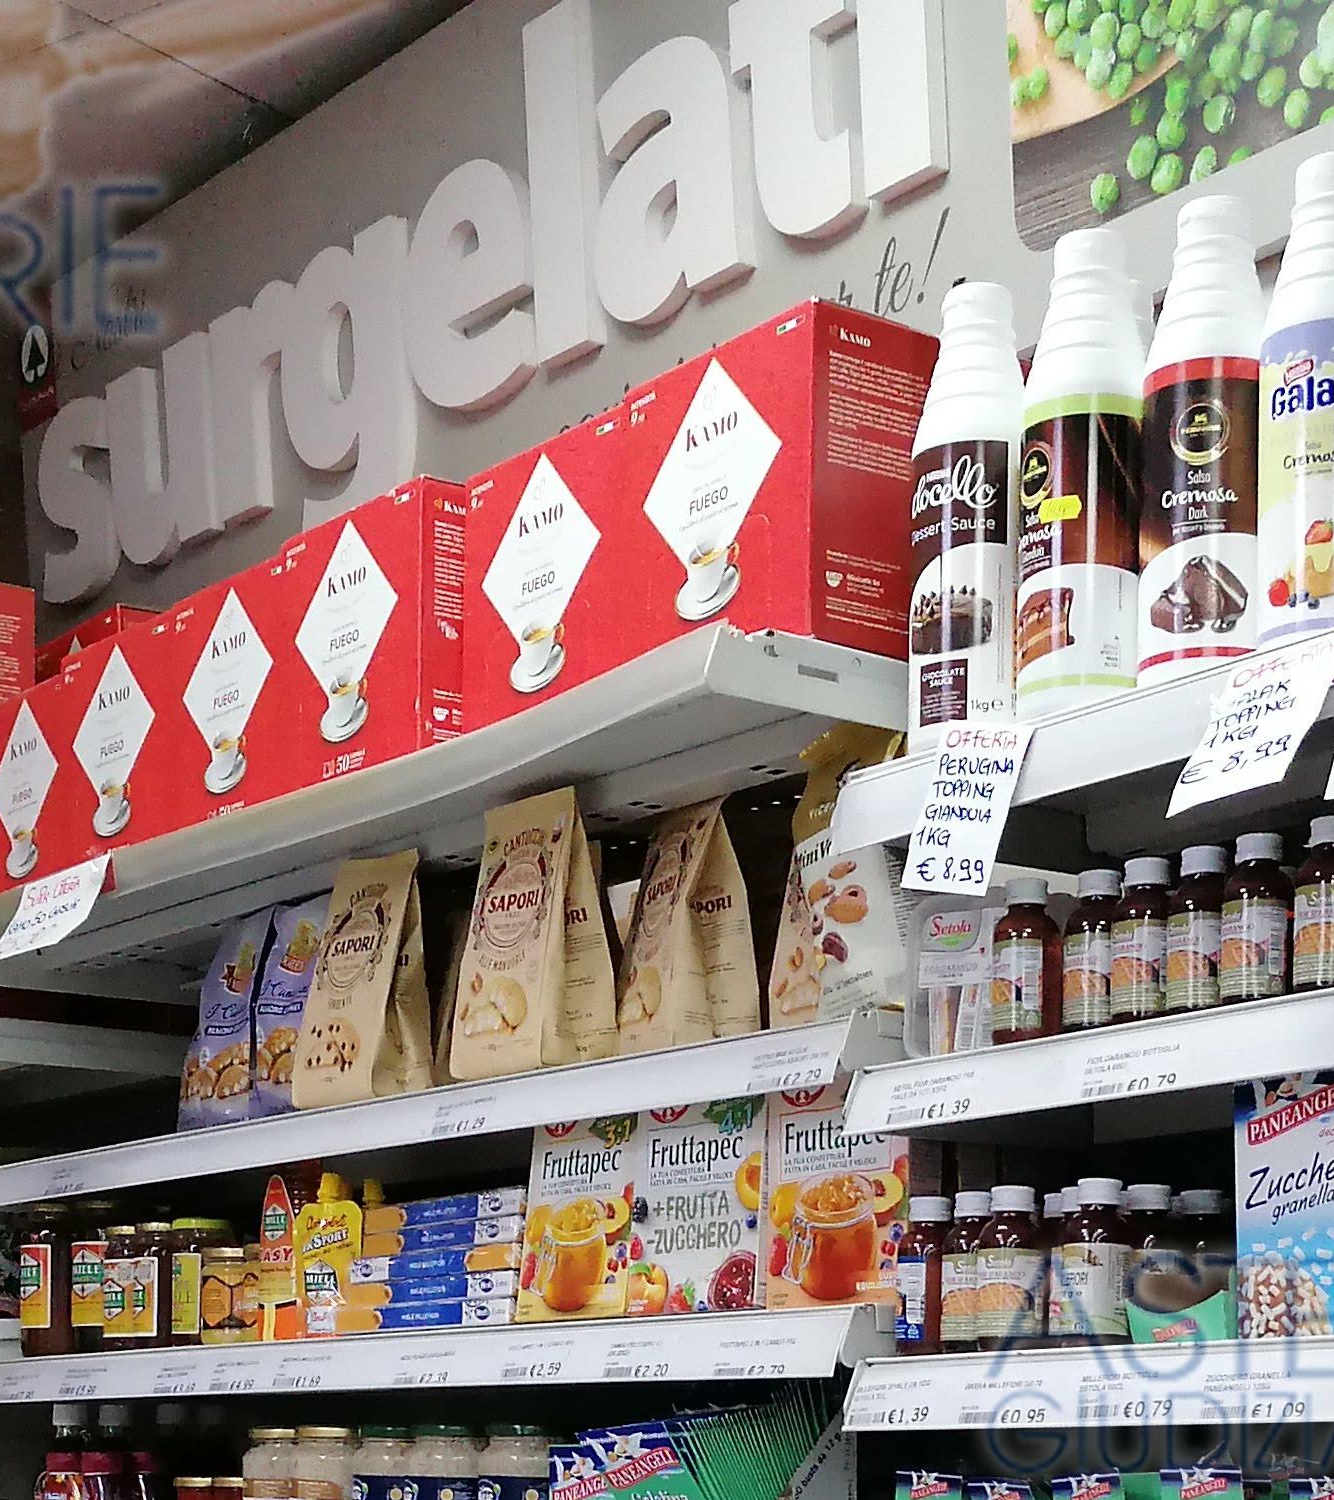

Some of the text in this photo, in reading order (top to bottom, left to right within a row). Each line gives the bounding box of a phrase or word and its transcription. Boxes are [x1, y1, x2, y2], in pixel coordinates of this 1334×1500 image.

[840, 328, 871, 347] KAMO
[686, 411, 738, 452] KAMO
[1187, 470, 1211, 485] Salsa
[689, 486, 729, 515] FUEGO
[1161, 490, 1238, 510] Cremosa
[519, 502, 563, 537] KAMO
[951, 516, 996, 532] Sauce
[1188, 507, 1208, 520] Dark
[327, 565, 367, 598] KAMO
[522, 571, 555, 595] FUEGO
[211, 632, 247, 660] KAMO
[330, 629, 359, 652] FUEGO
[98, 685, 131, 711] KAMO
[213, 689, 240, 709] FUEGO
[9, 737, 38, 762] KAMO
[946, 728, 1017, 750] OFFERTA
[940, 754, 1015, 777] PERUGINA
[933, 780, 995, 801] TOPPING
[916, 828, 951, 848] 1KG
[488, 888, 539, 914] SAPORI
[929, 917, 971, 937] Setola
[331, 935, 375, 958] SAPORI
[542, 1146, 622, 1180] Fruttapec
[651, 1135, 744, 1168] Fruttapec
[609, 1450, 675, 1485] PANEANGELI
